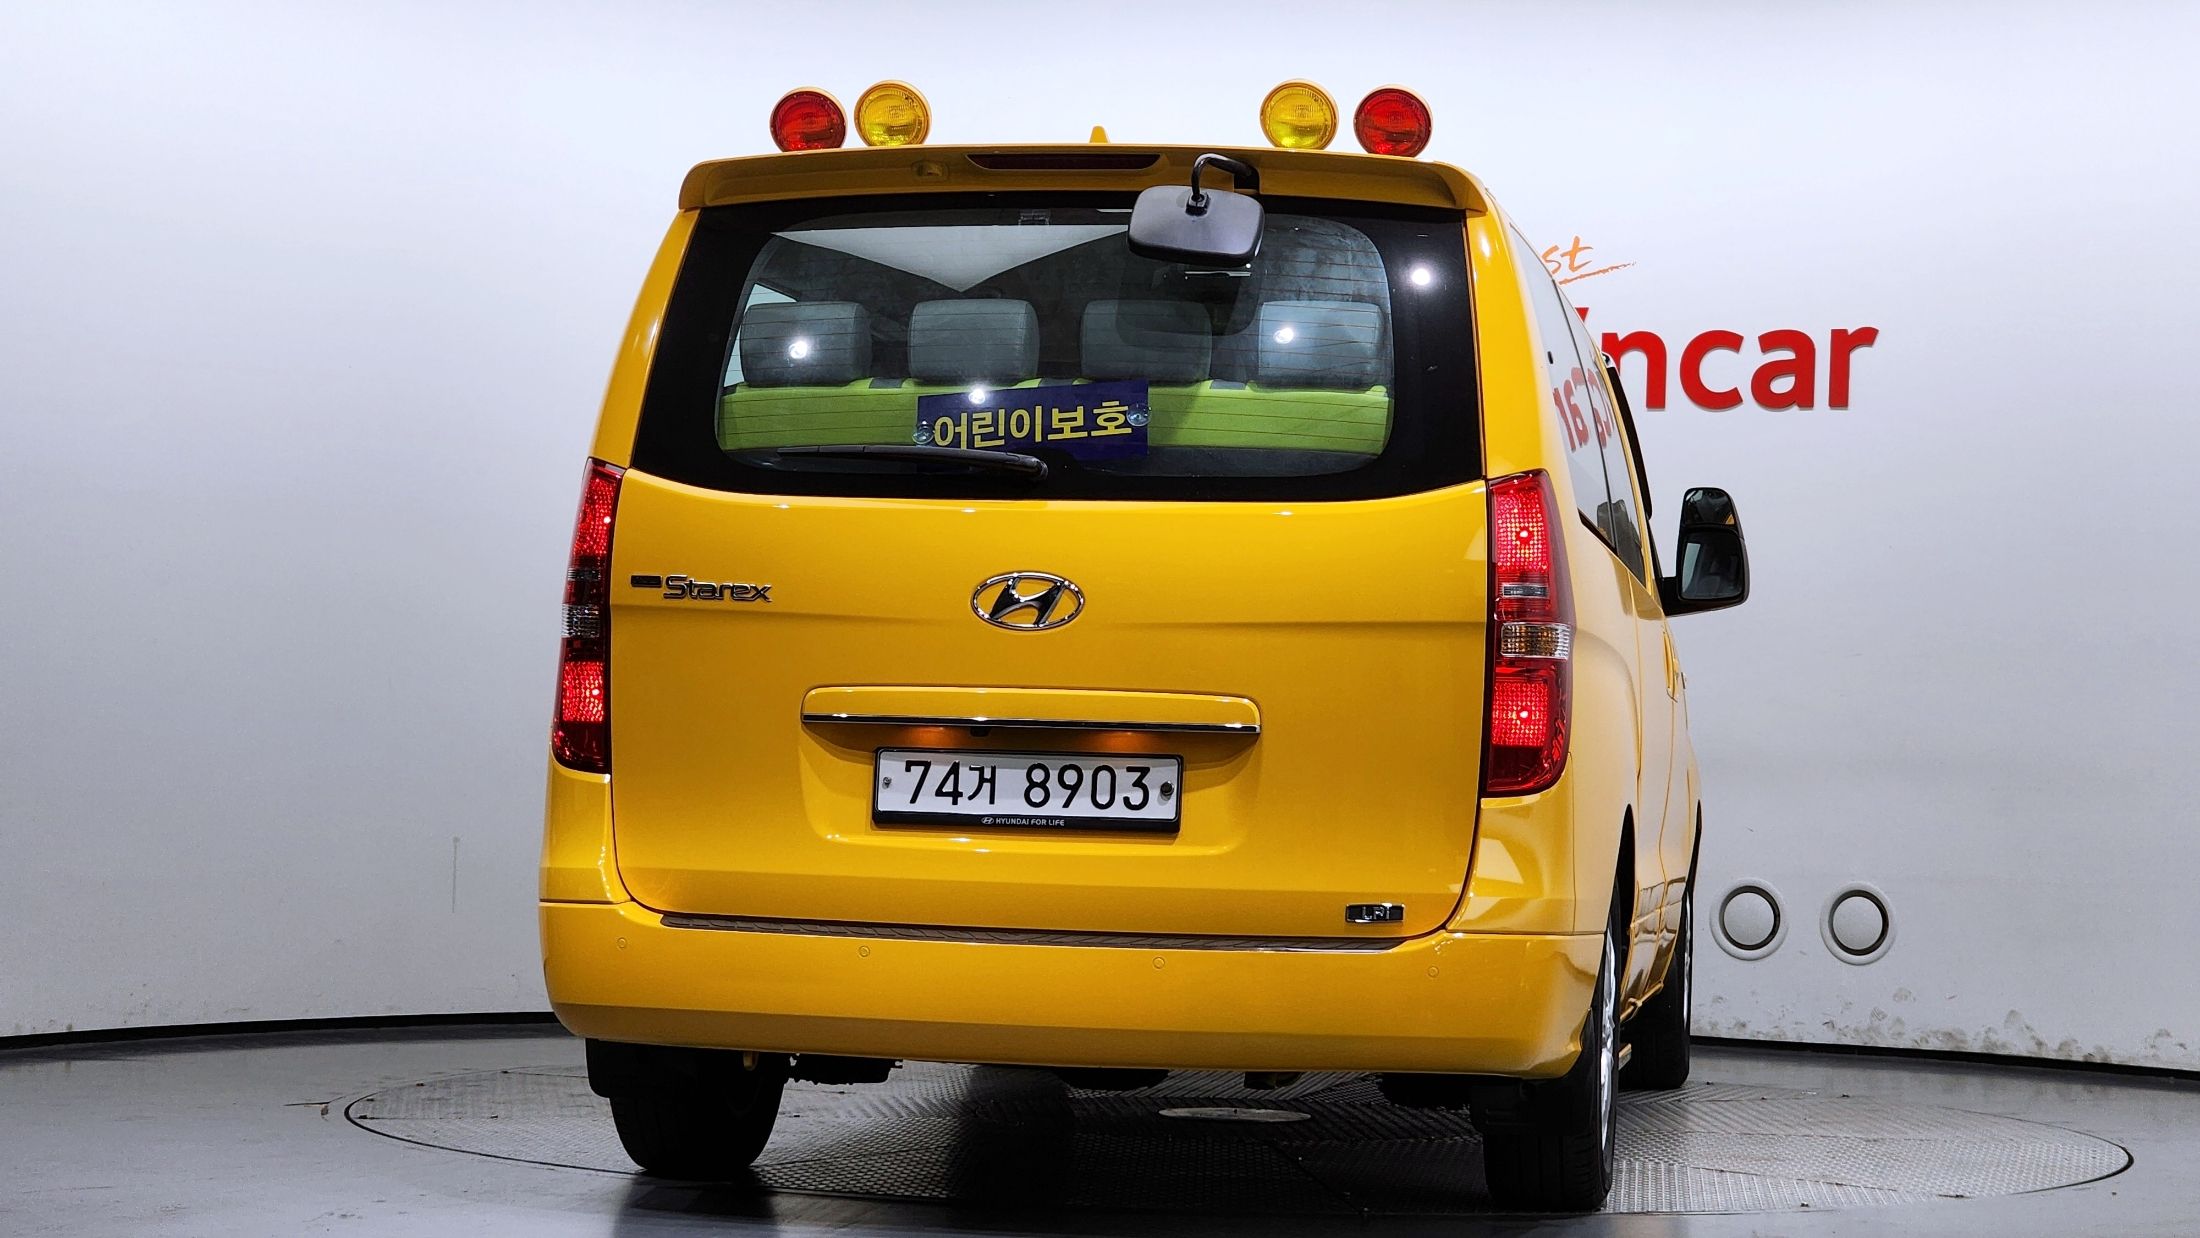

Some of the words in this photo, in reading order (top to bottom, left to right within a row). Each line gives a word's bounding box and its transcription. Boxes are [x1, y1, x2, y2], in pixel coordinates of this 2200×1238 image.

[1575, 307, 1879, 410] ncar
[934, 400, 1132, 449] 어린이보호
[663, 574, 773, 602] Starex
[905, 760, 996, 806] 74거
[1024, 762, 1150, 811] 8903
[995, 816, 1029, 825] HYUNDAI
[1031, 817, 1047, 826] FOR
[1048, 818, 1065, 827] LIFE
